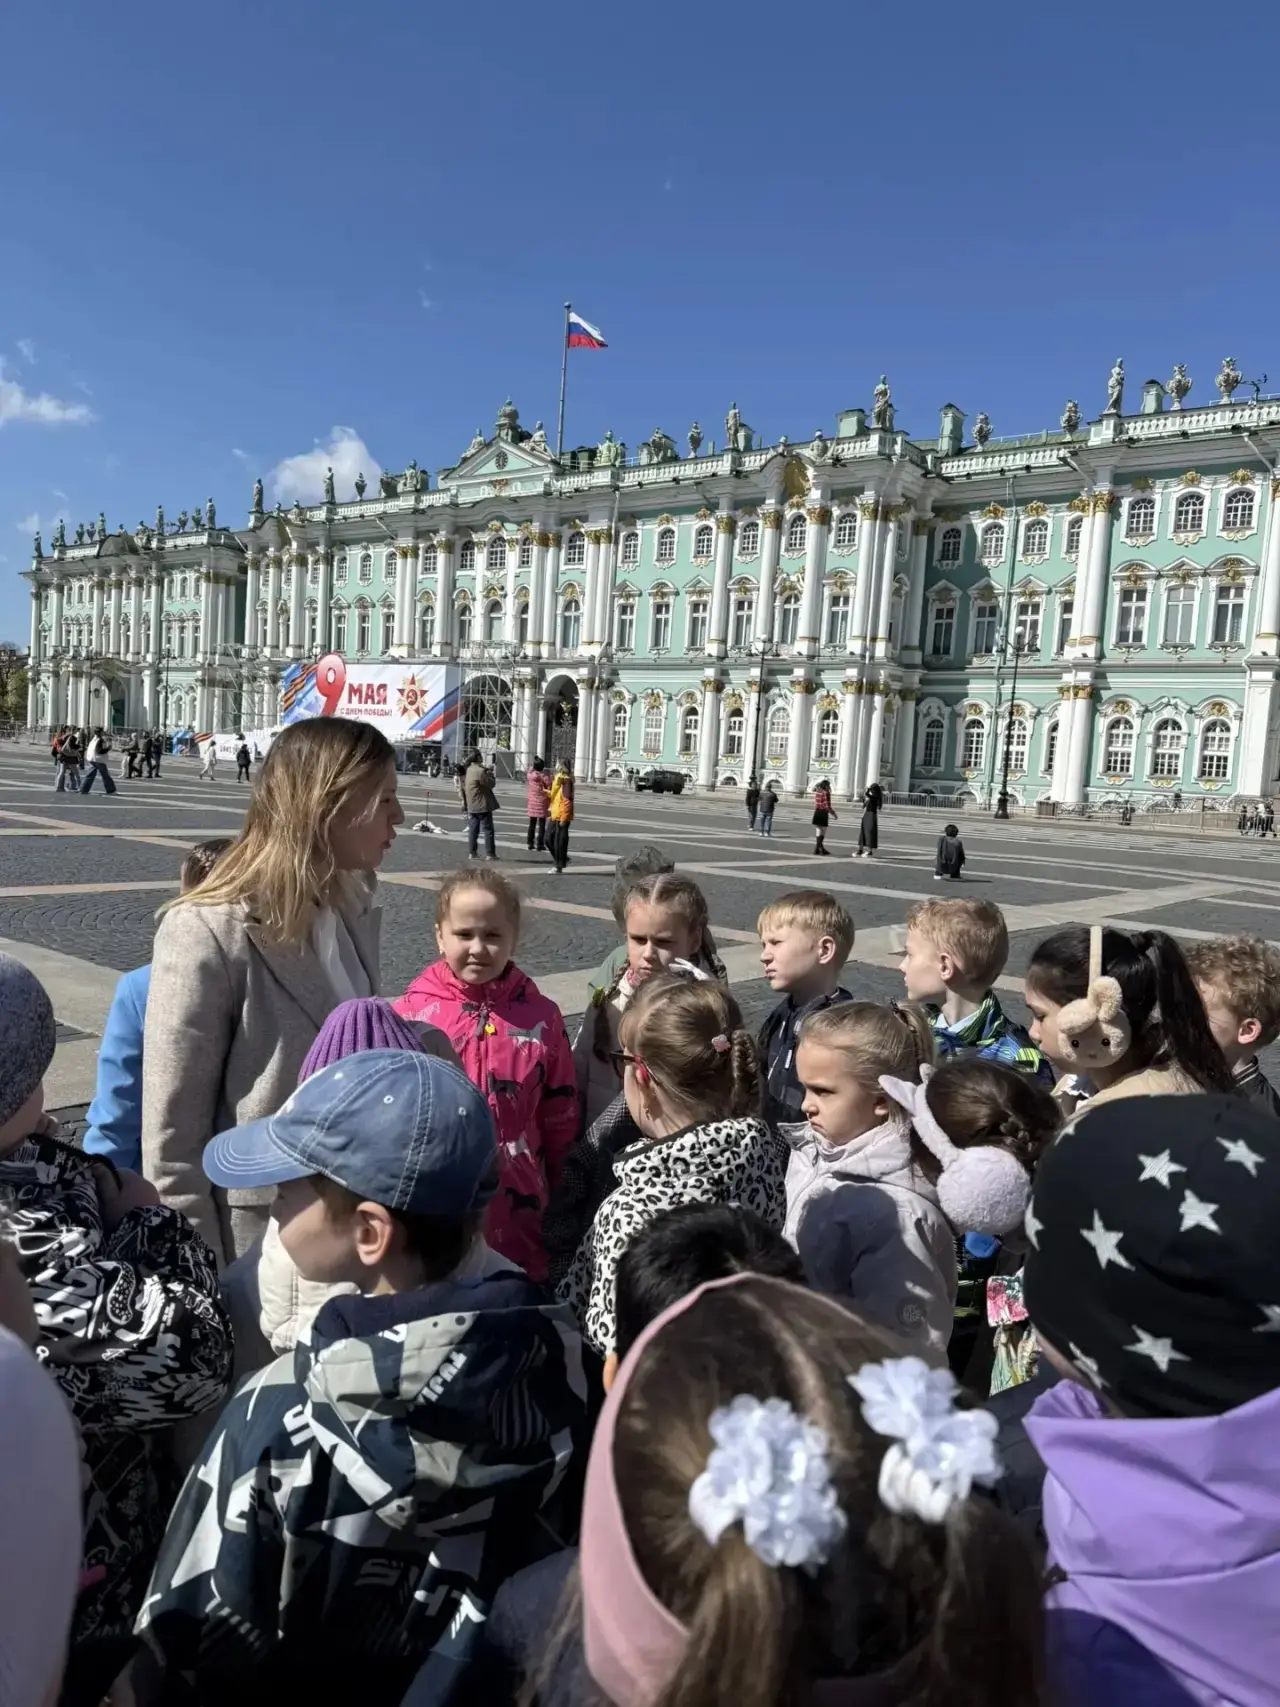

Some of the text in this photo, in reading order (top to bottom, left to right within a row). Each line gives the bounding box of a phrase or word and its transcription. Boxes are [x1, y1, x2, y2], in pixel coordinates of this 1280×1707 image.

[316, 653, 388, 717] 9 МАЯ
[363, 708, 393, 717] ПОБЕДЫ!
